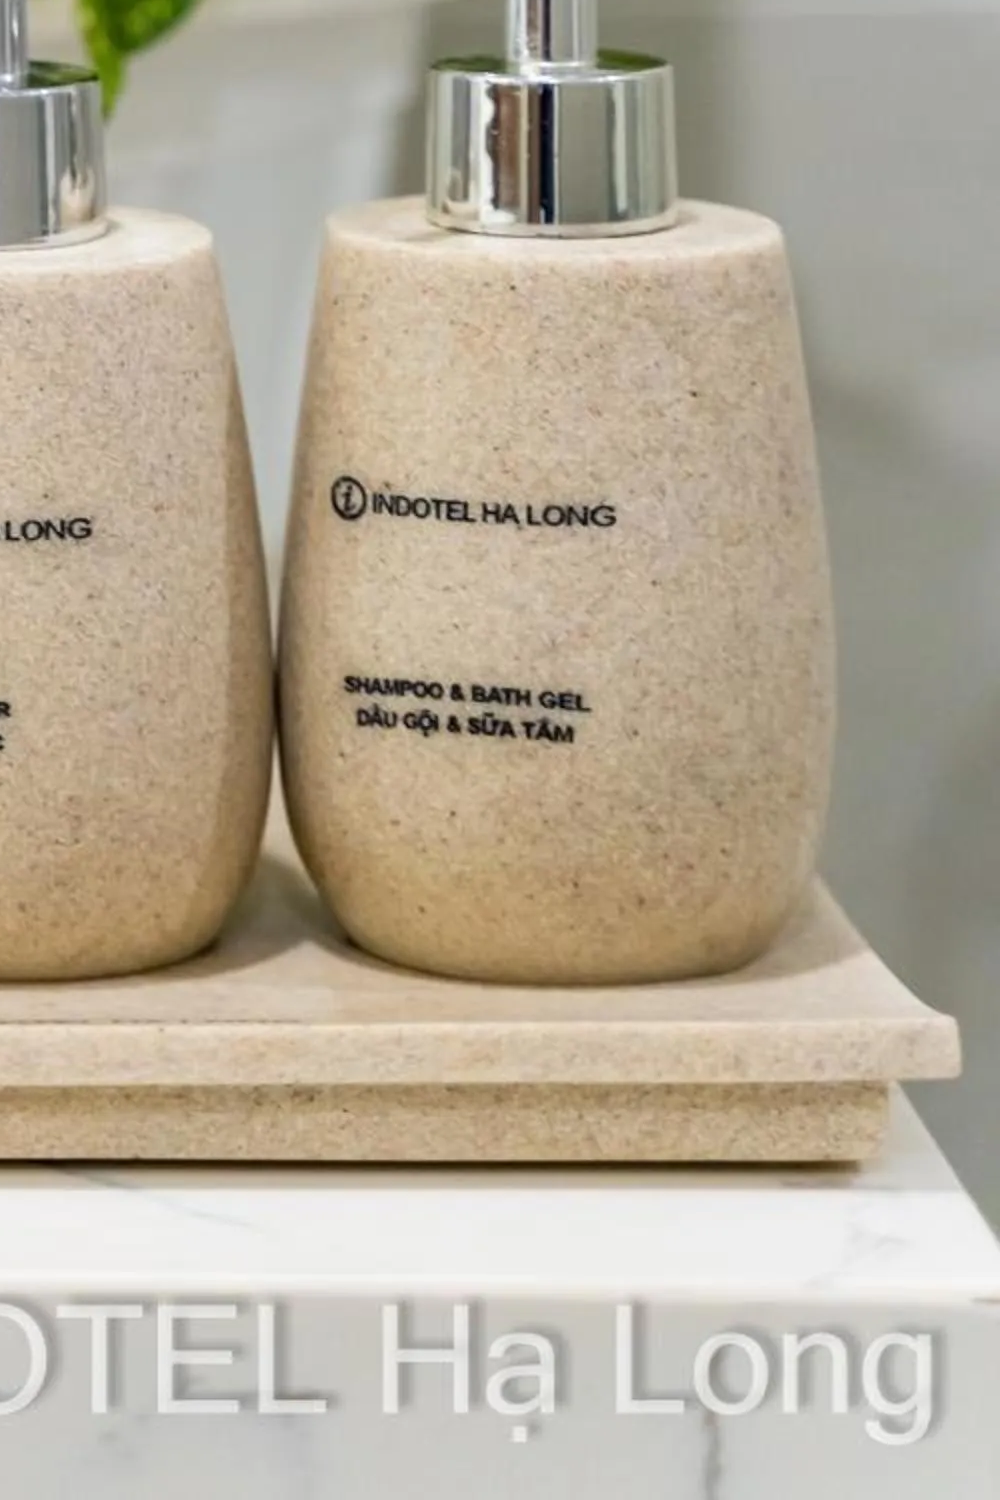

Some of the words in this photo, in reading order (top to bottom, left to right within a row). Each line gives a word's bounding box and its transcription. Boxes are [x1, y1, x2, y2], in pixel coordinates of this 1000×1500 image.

[372, 493, 476, 523] INDOTEL
[526, 504, 617, 527] LONG
[5, 518, 93, 541] LONG
[344, 675, 445, 700] SHAMPOO
[450, 683, 465, 701] &
[471, 685, 532, 706] BATH
[538, 691, 591, 712] GEL
[446, 715, 461, 734] &
